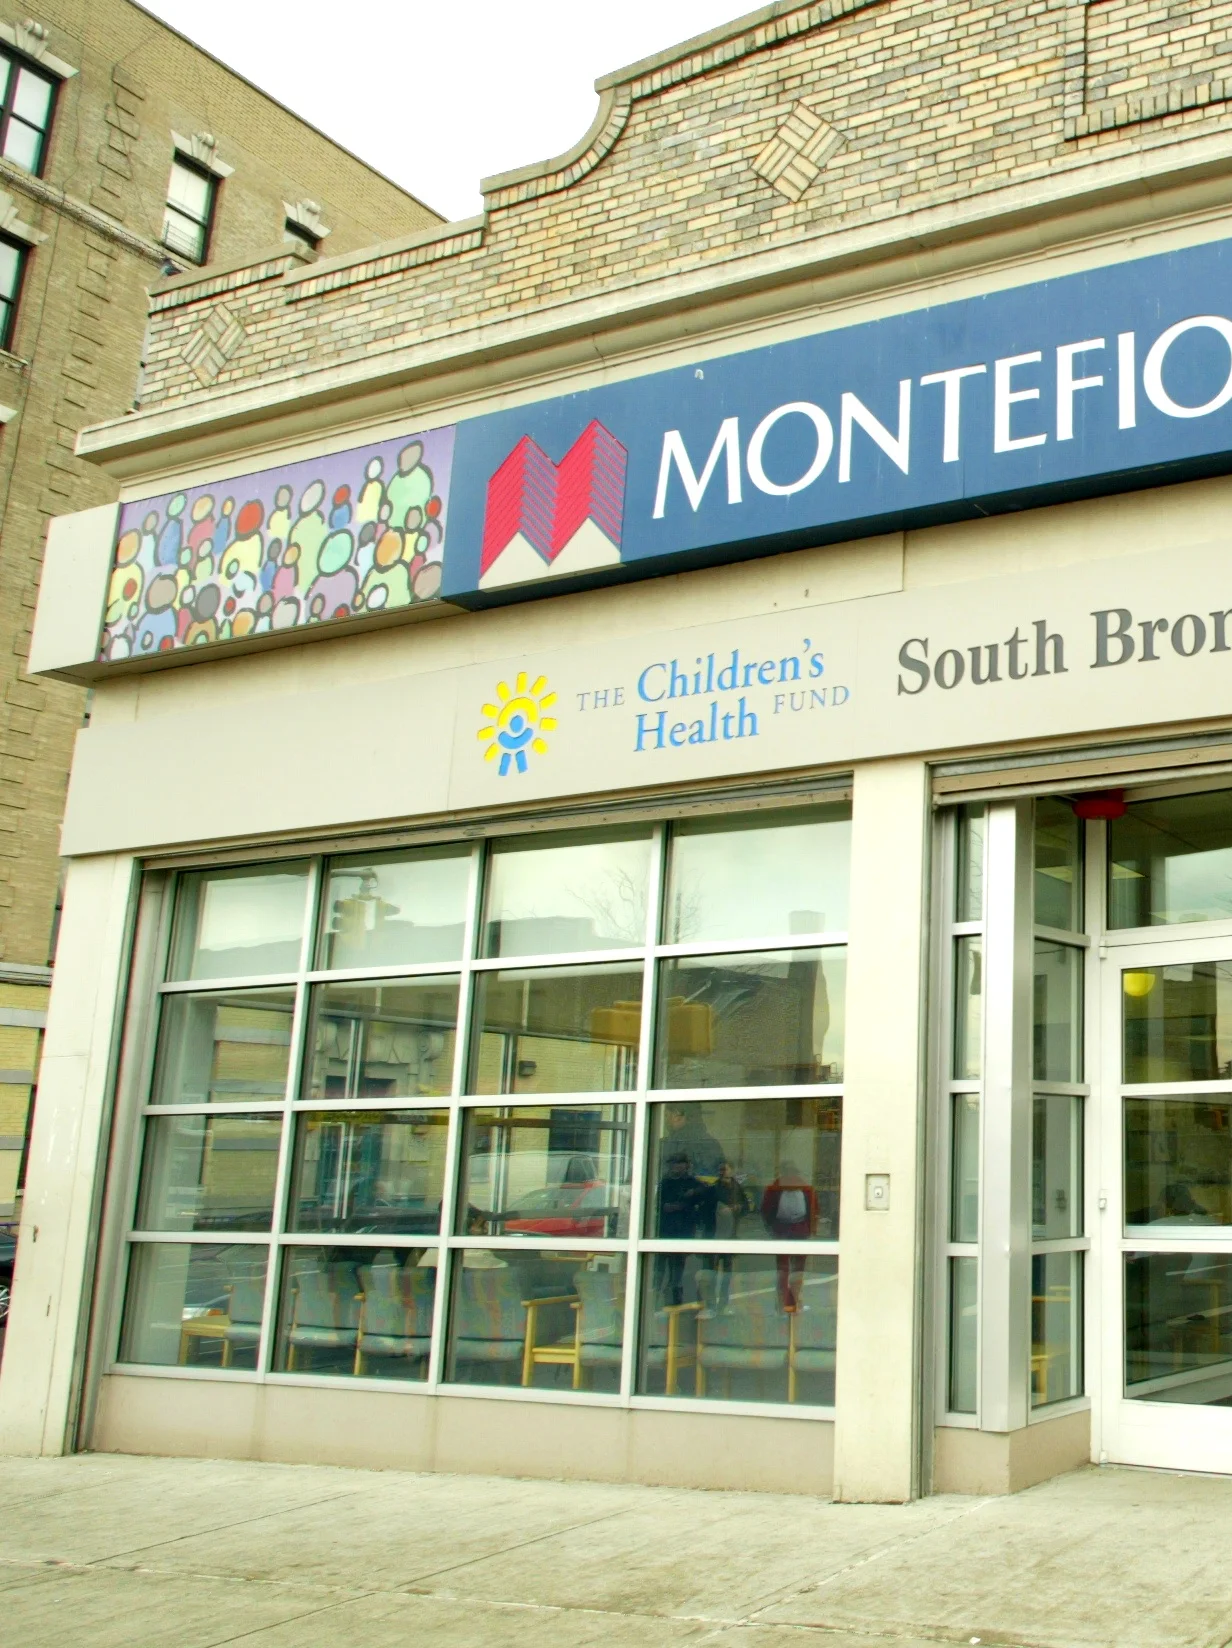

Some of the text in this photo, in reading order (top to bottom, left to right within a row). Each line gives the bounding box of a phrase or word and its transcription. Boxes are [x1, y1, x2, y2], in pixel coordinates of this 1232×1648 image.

[576, 638, 824, 712] THE Children's
[897, 619, 1069, 696] South
[634, 685, 850, 752] Health FUND
